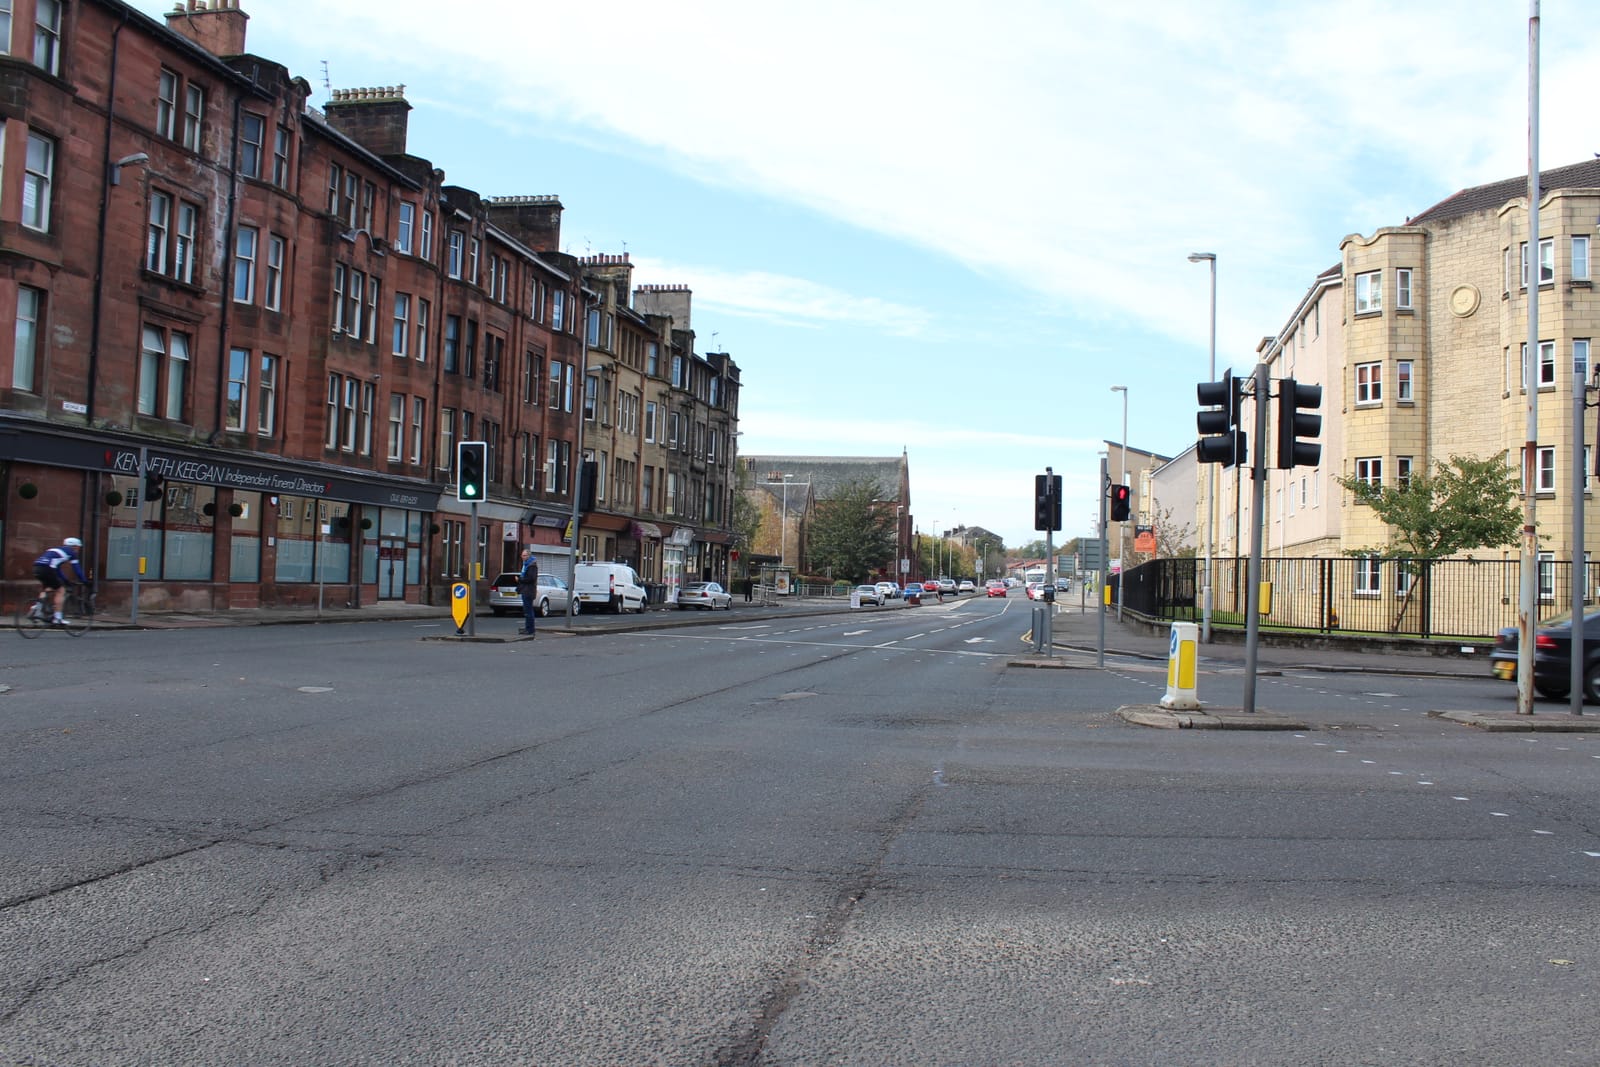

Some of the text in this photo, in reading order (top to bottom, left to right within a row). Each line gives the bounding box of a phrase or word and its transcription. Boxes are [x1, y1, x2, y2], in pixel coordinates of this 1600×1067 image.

[175, 461, 224, 482] KEEGAN
[225, 468, 271, 486] Independent
[271, 475, 296, 489] Funeral
[296, 478, 325, 493] Directors
